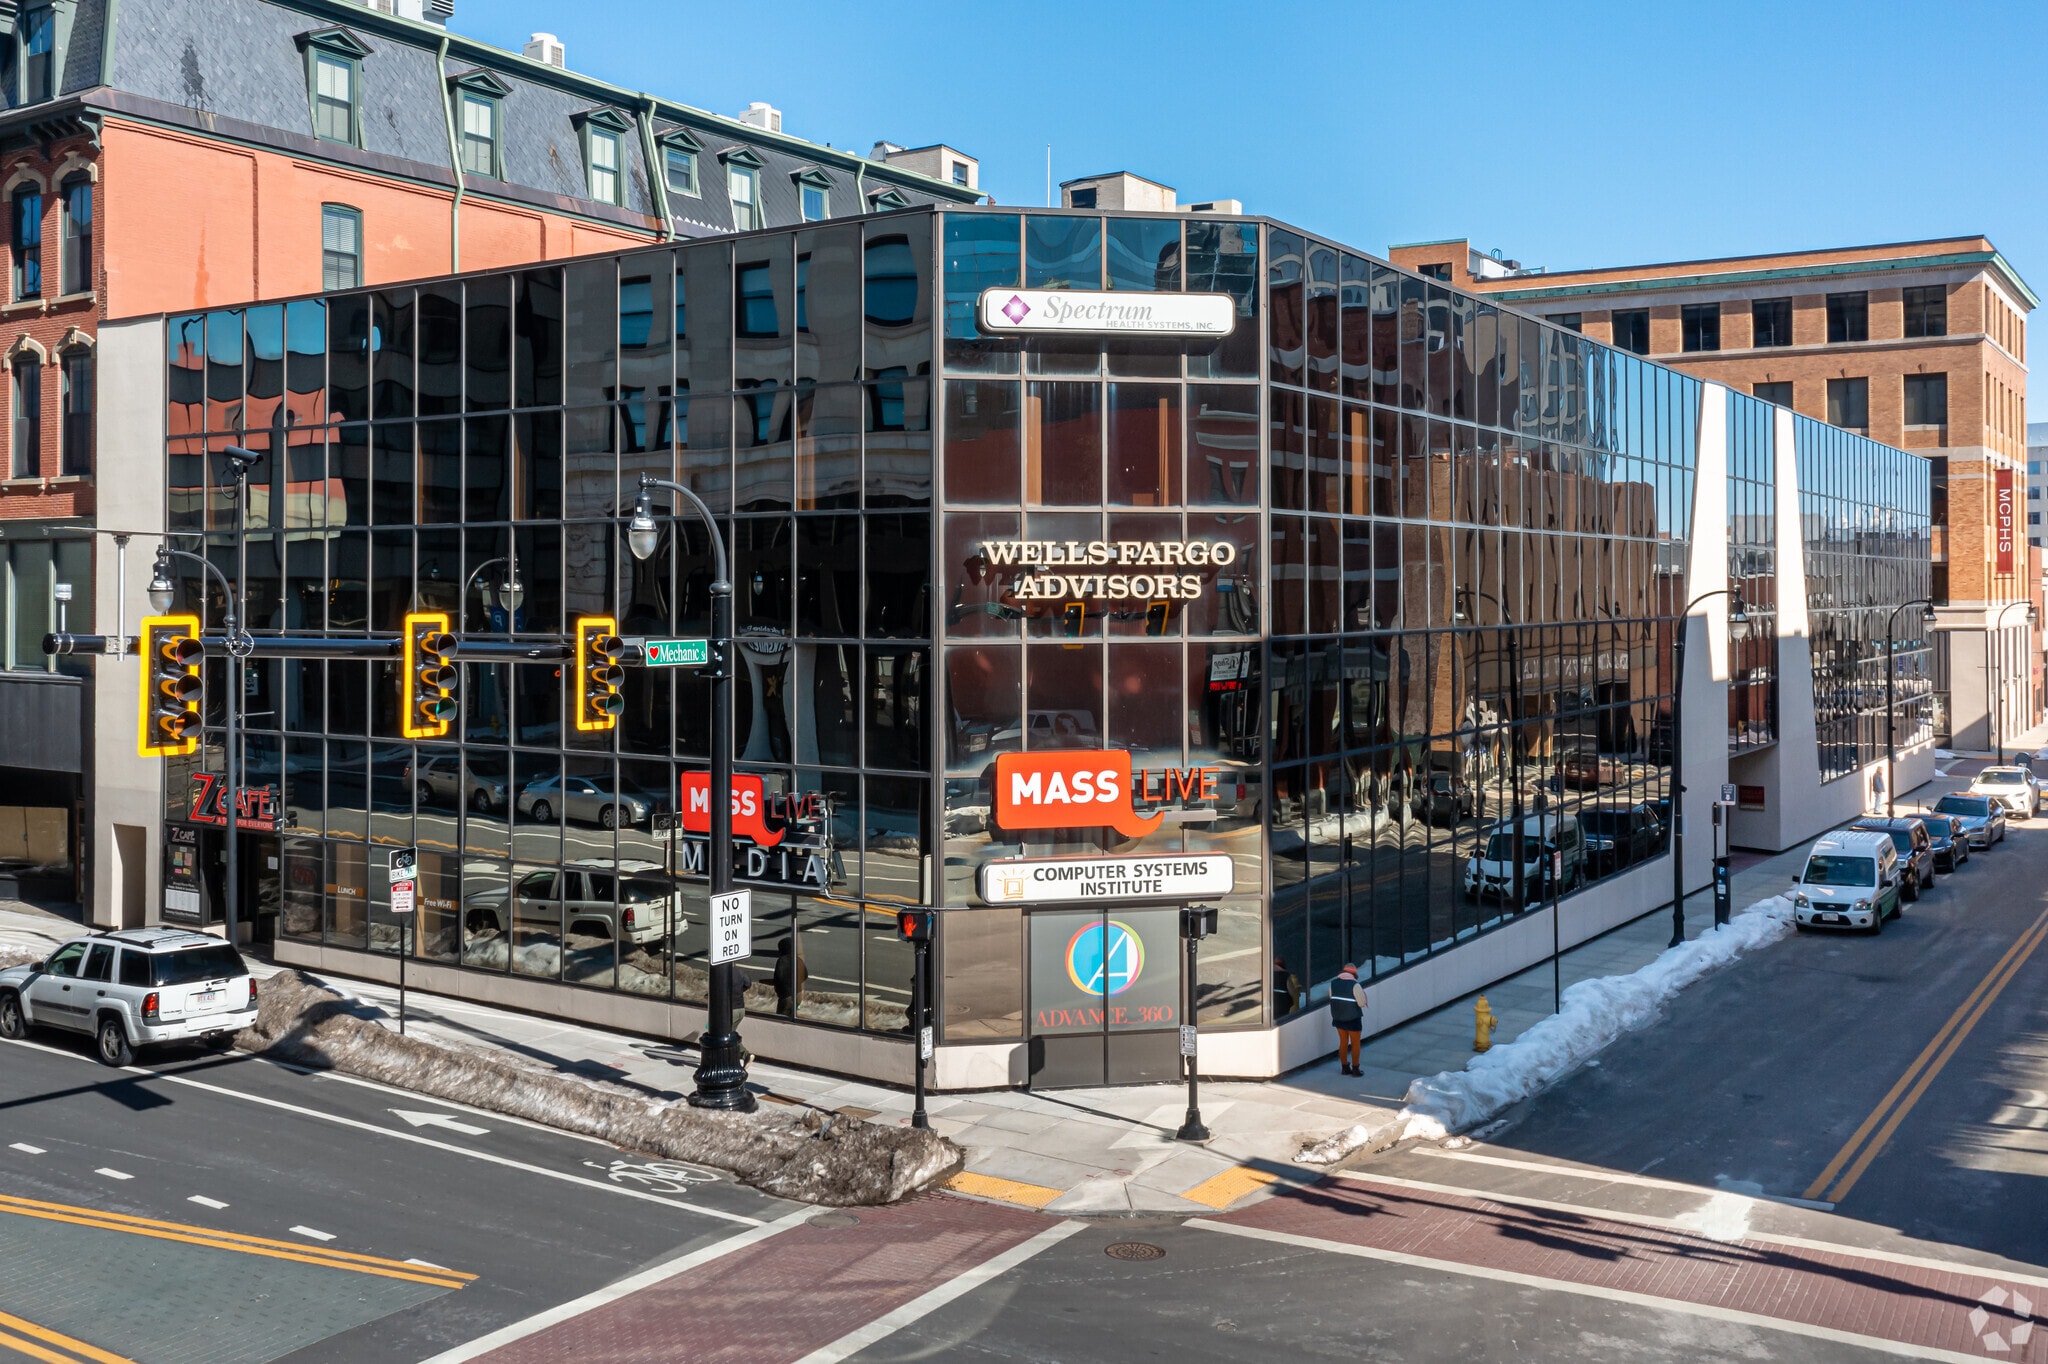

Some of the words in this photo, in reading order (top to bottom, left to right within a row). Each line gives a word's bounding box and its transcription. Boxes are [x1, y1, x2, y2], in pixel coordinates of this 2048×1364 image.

[1043, 295, 1152, 324] Spectrum
[1106, 320, 1145, 329] HEALTH
[1148, 321, 1193, 330] SYSTEMS,
[1196, 321, 1216, 330] INC.
[1999, 488, 2011, 553] MCPHS
[982, 541, 1109, 566] WELLS
[1117, 541, 1236, 566] FARGO
[1014, 574, 1202, 600] ADVISORS
[660, 643, 700, 663] Mechanic
[1011, 770, 1120, 806] MASS
[1142, 767, 1221, 802] LIVE
[189, 772, 216, 823] Z
[690, 786, 756, 817] MSS
[771, 791, 822, 822] LIVE
[682, 842, 827, 884] MDIA
[1033, 864, 1126, 882] COMPUTER
[1133, 861, 1208, 878] SYSTEMS
[391, 868, 404, 879] BIKE
[1080, 879, 1162, 896] INSTITUTE
[424, 897, 437, 907] Free
[437, 899, 452, 909] Wi-Fi
[722, 897, 740, 912] NO
[719, 913, 743, 928] TURN
[724, 929, 738, 941] ON
[722, 943, 740, 957] RED
